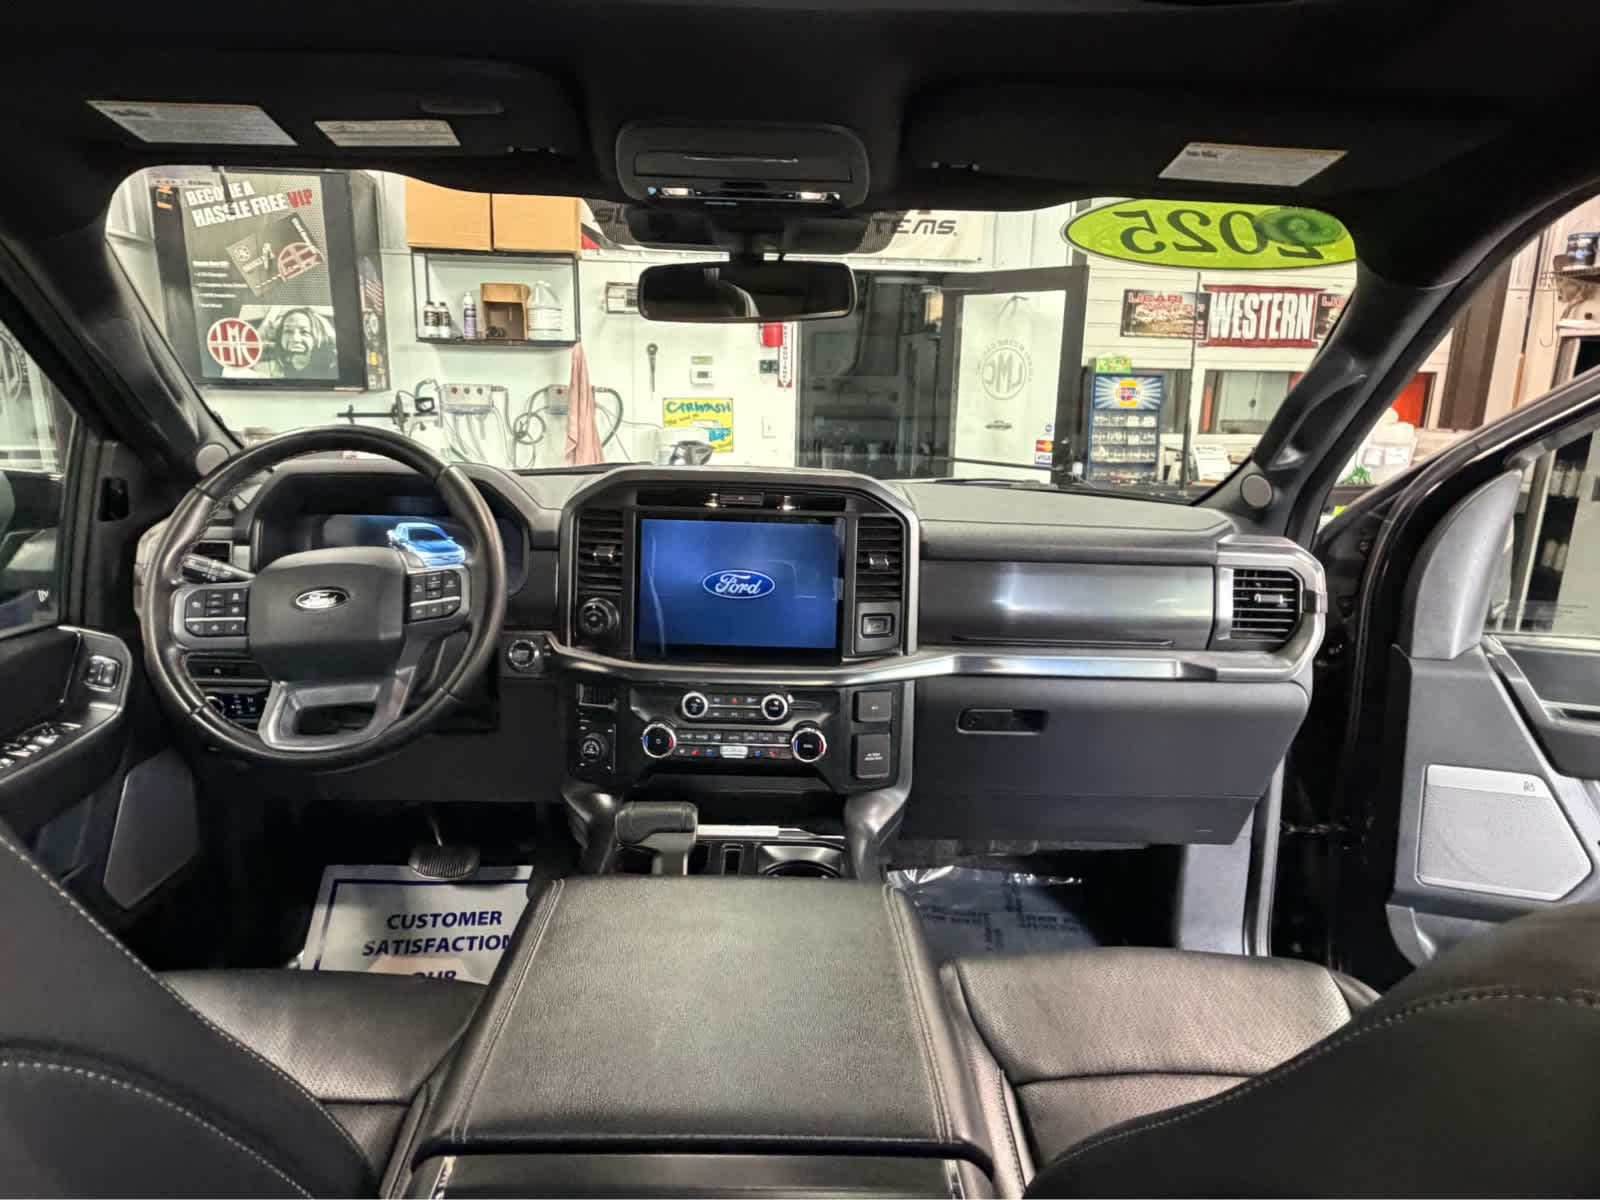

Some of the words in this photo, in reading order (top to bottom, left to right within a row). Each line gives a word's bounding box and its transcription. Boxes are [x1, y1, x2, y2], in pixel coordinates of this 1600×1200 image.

[243, 181, 256, 197] A
[249, 192, 289, 215] FREE
[287, 188, 313, 208] VIP
[1208, 292, 1315, 340] WESTERN
[715, 575, 761, 595] Ford
[386, 910, 503, 930] CUSTOMER
